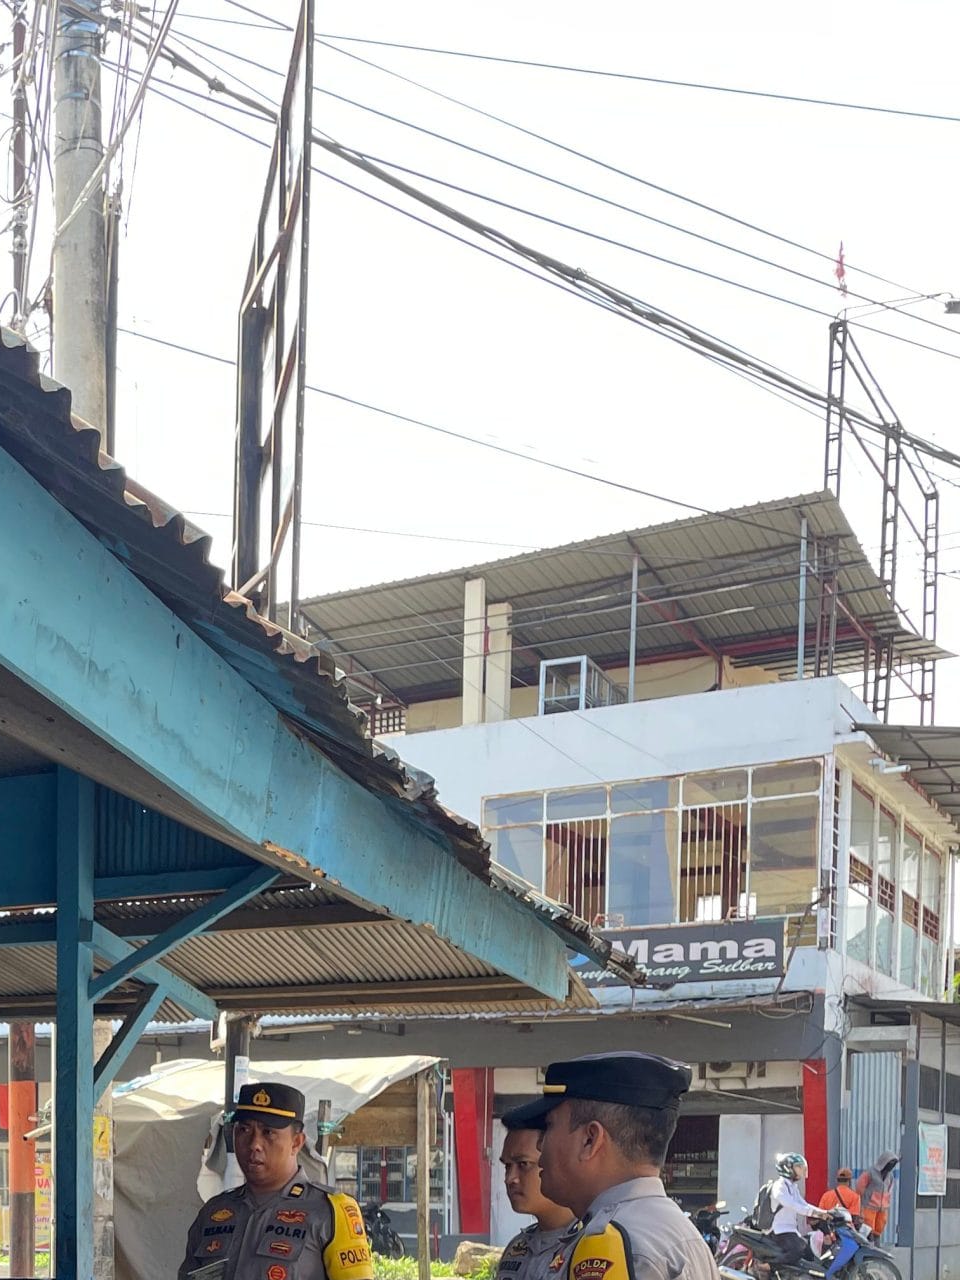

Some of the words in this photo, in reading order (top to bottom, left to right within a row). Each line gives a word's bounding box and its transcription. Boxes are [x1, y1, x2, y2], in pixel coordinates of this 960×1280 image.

[611, 937, 776, 964] Mama
[699, 958, 776, 974] Sulbar
[265, 1225, 307, 1239] POLRI
[575, 1259, 607, 1273] POLDA
